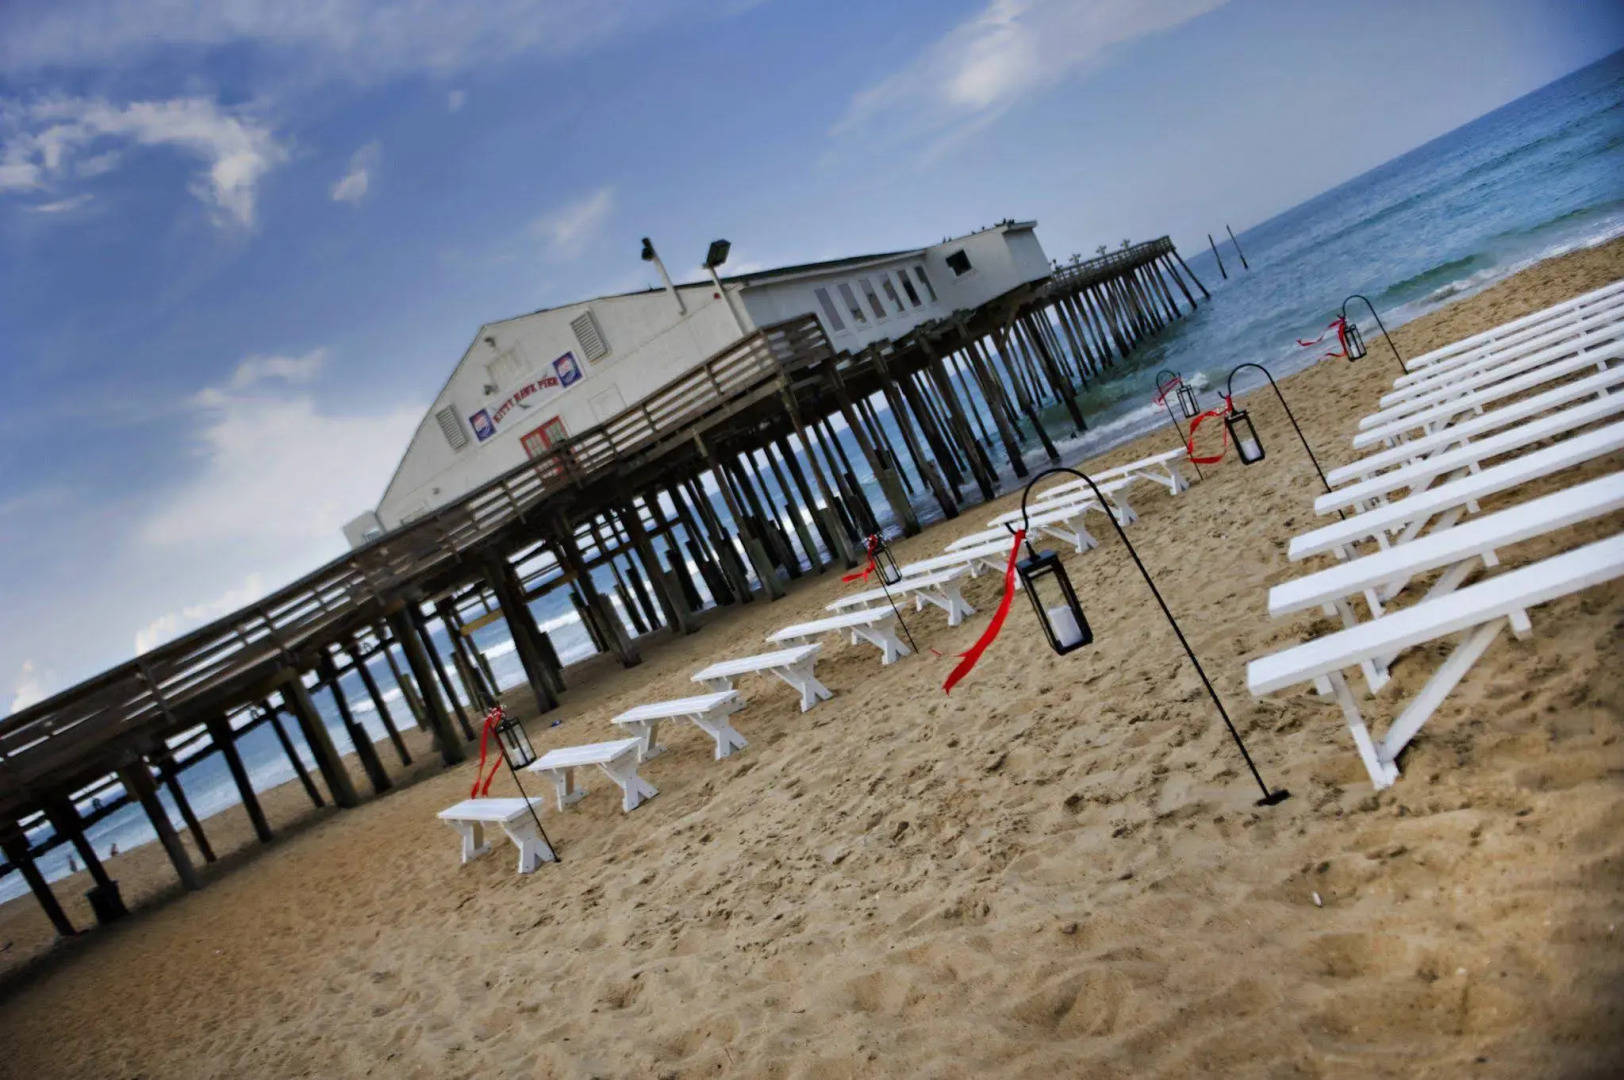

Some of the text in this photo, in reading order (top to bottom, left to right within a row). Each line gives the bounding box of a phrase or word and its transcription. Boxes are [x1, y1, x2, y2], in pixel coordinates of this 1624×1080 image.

[492, 398, 515, 424] KITTY
[513, 383, 538, 403] HAWK
[537, 376, 560, 390] PIER
